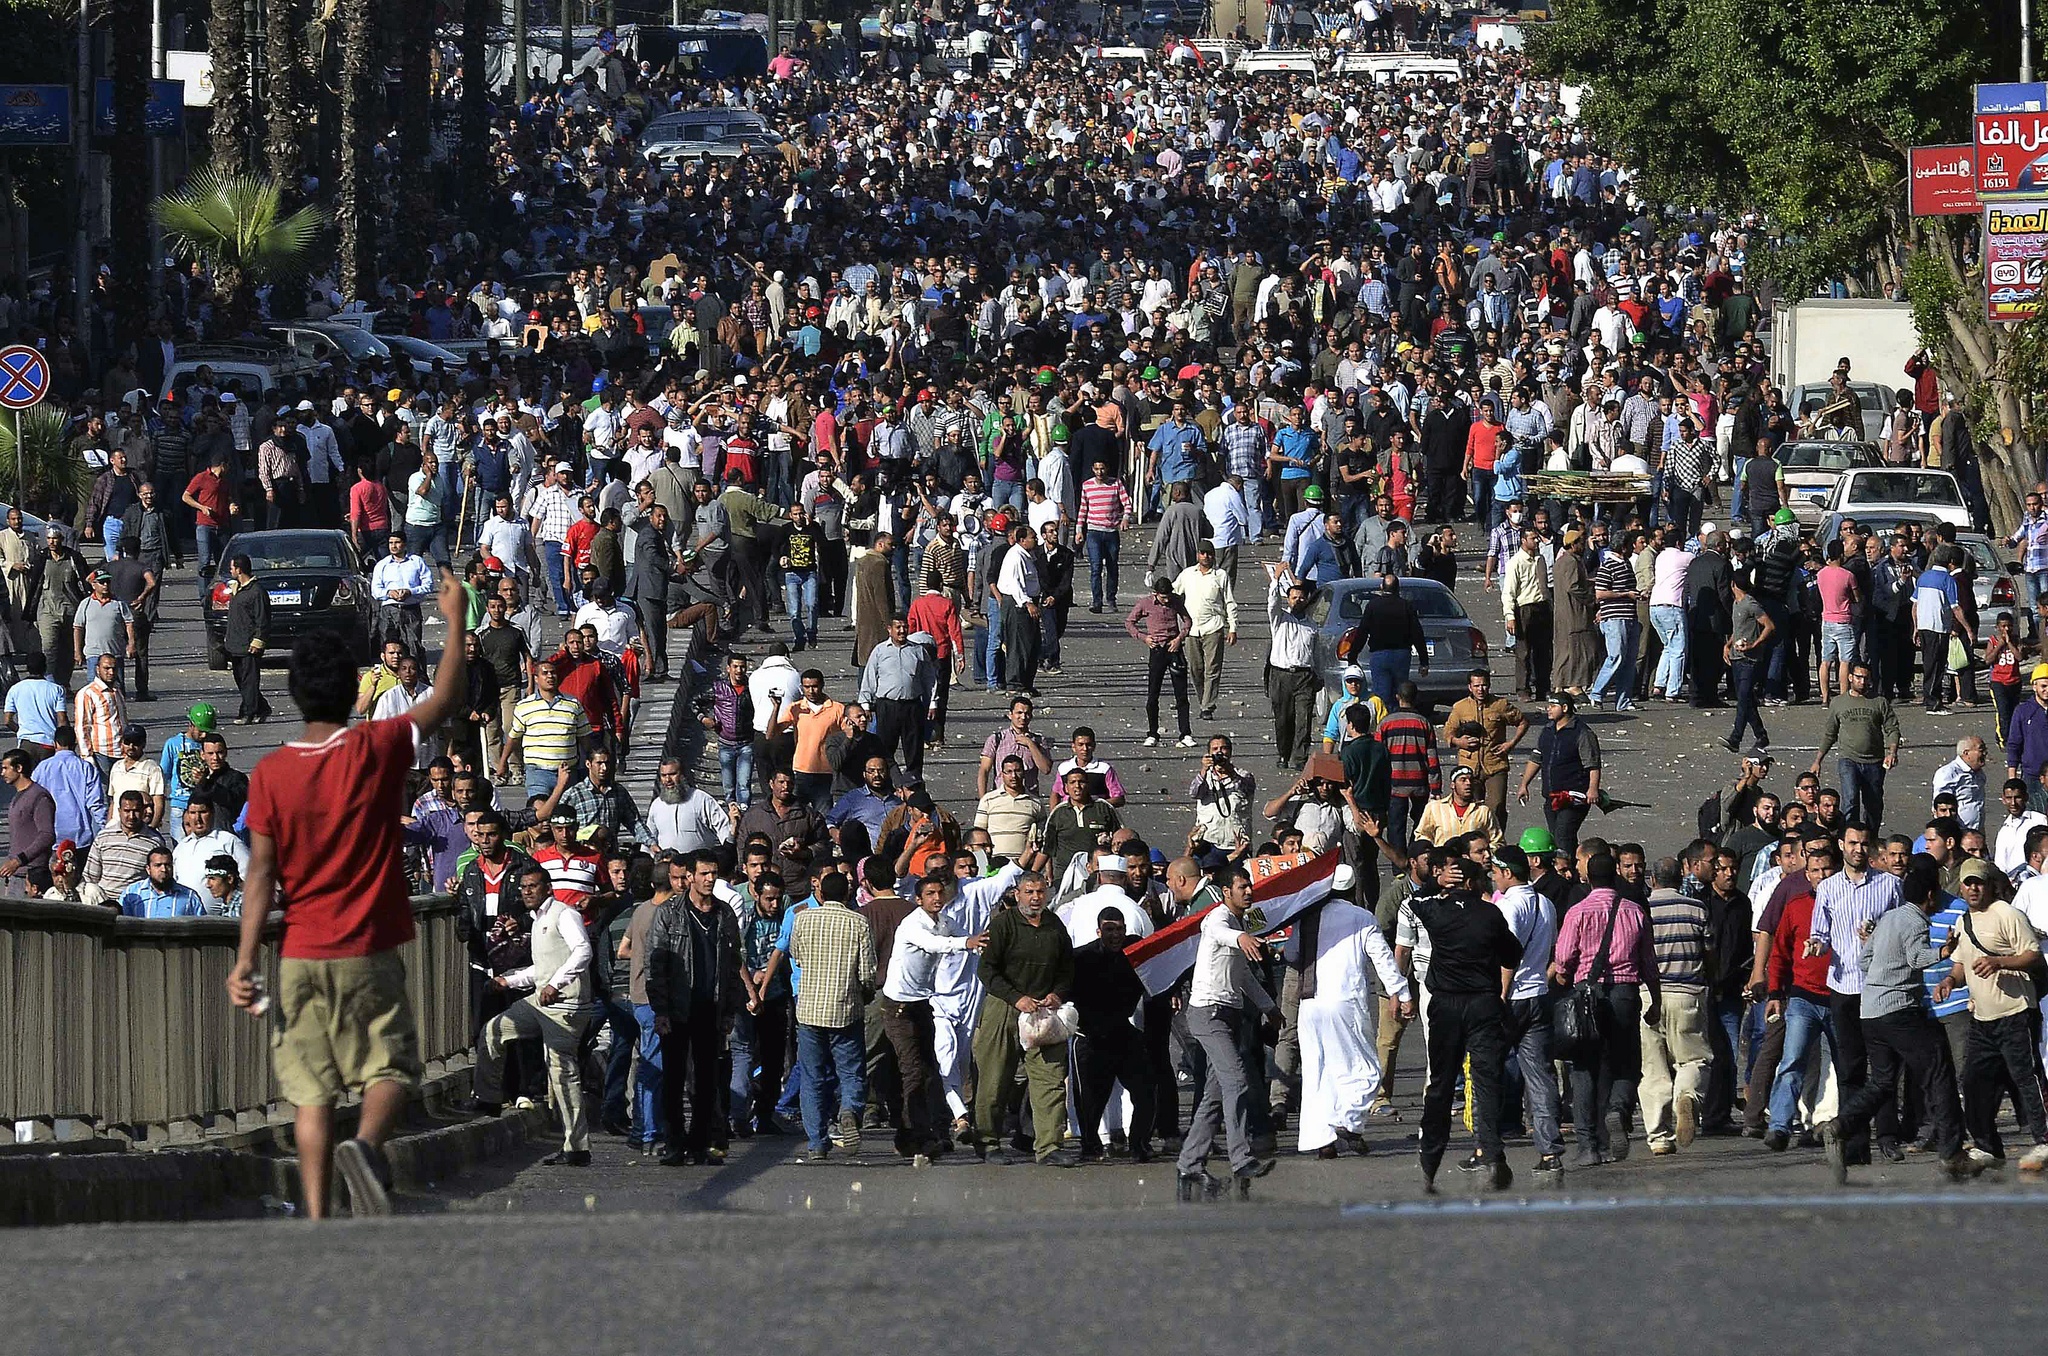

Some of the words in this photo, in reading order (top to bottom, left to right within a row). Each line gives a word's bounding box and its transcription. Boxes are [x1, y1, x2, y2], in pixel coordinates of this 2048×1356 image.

[1915, 160, 1958, 179] للتأمين
[1983, 178, 2009, 188] 16191
[1997, 269, 2015, 277] BYD
